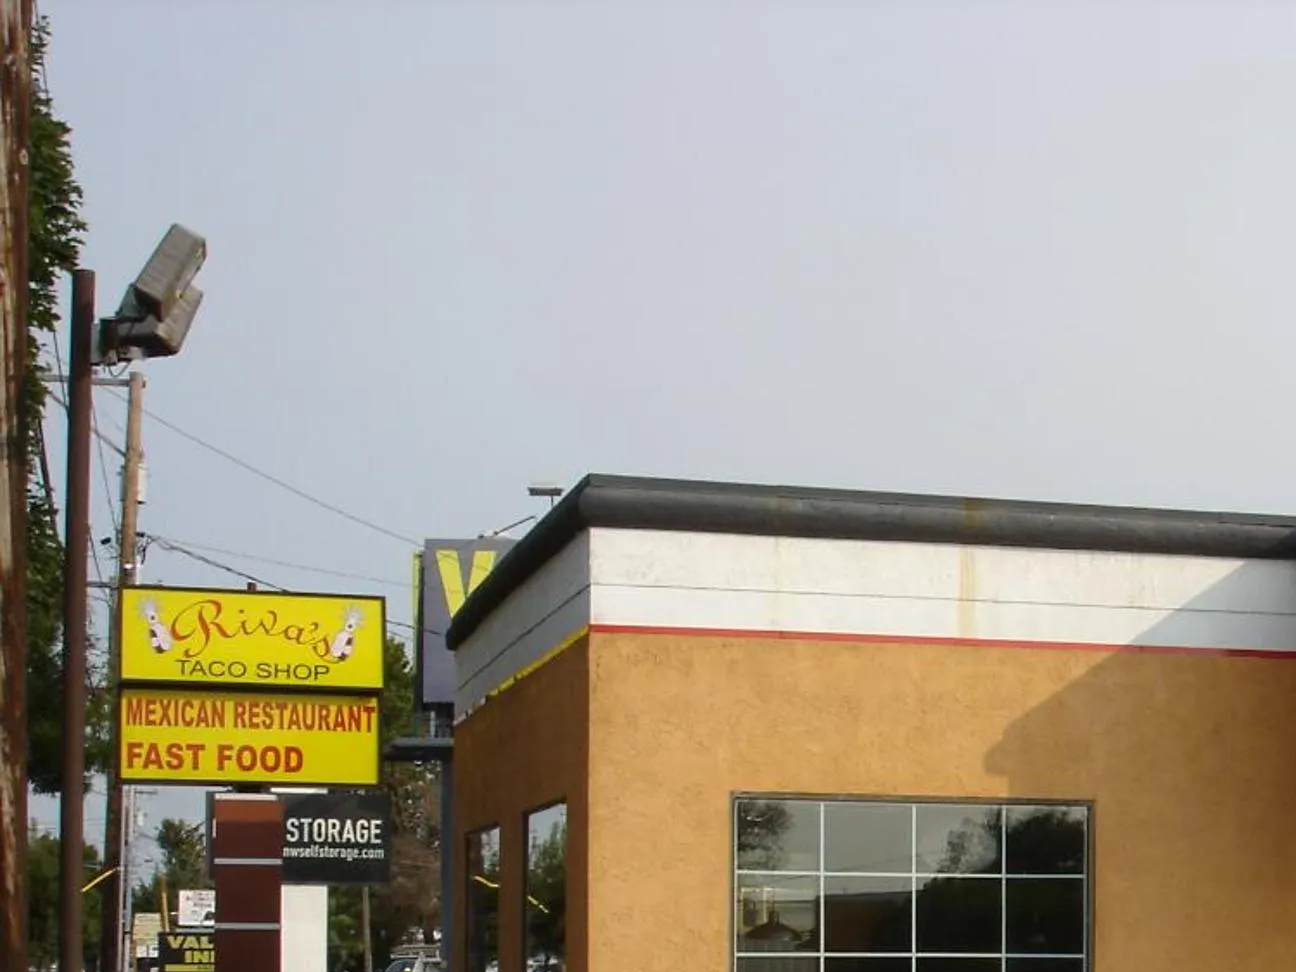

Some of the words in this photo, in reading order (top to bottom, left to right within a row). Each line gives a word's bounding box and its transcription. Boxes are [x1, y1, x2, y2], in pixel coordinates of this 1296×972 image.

[171, 600, 343, 664] Riva's
[175, 660, 247, 678] TACO
[257, 662, 331, 681] SHOP
[126, 697, 226, 728] MEXICAN
[234, 700, 376, 733] RESTAURANT
[126, 742, 205, 770] FAST
[216, 744, 304, 773] FOOD
[286, 818, 383, 844] STORAGE
[283, 845, 385, 861] nwselfstorage.com
